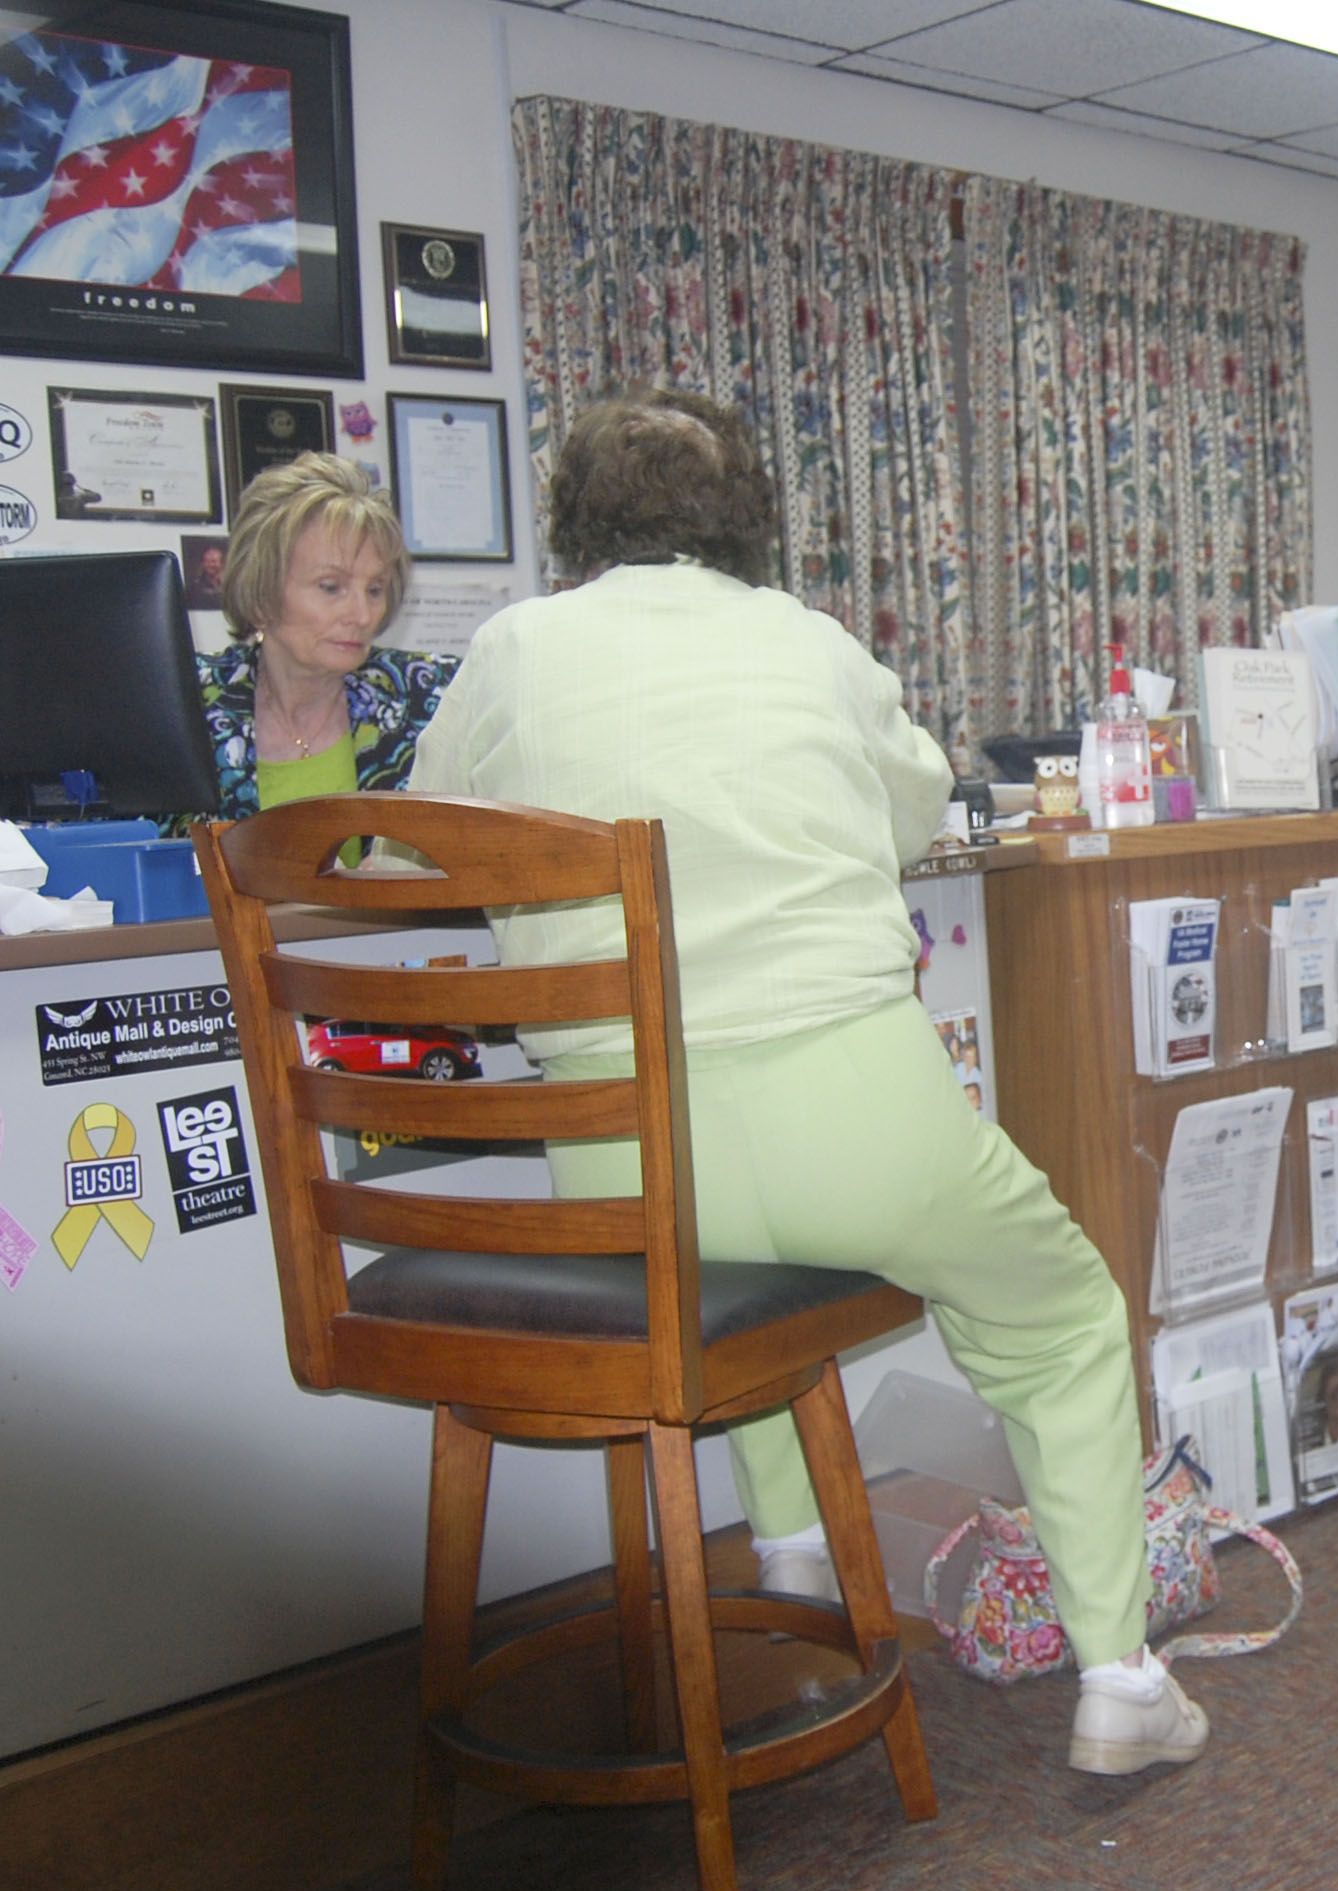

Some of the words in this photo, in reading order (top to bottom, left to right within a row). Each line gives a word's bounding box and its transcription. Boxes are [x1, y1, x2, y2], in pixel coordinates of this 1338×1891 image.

[84, 291, 196, 313] freedom
[0, 419, 21, 449] Q
[105, 990, 205, 1020] WHITE
[210, 988, 231, 1007] O
[46, 1029, 111, 1052] Antique
[115, 1022, 149, 1042] Mall
[152, 1021, 165, 1038] &
[169, 1014, 224, 1035] Design
[83, 1165, 126, 1195] USO
[182, 1182, 246, 1212] theatre
[191, 1204, 244, 1225] leestreet.org
